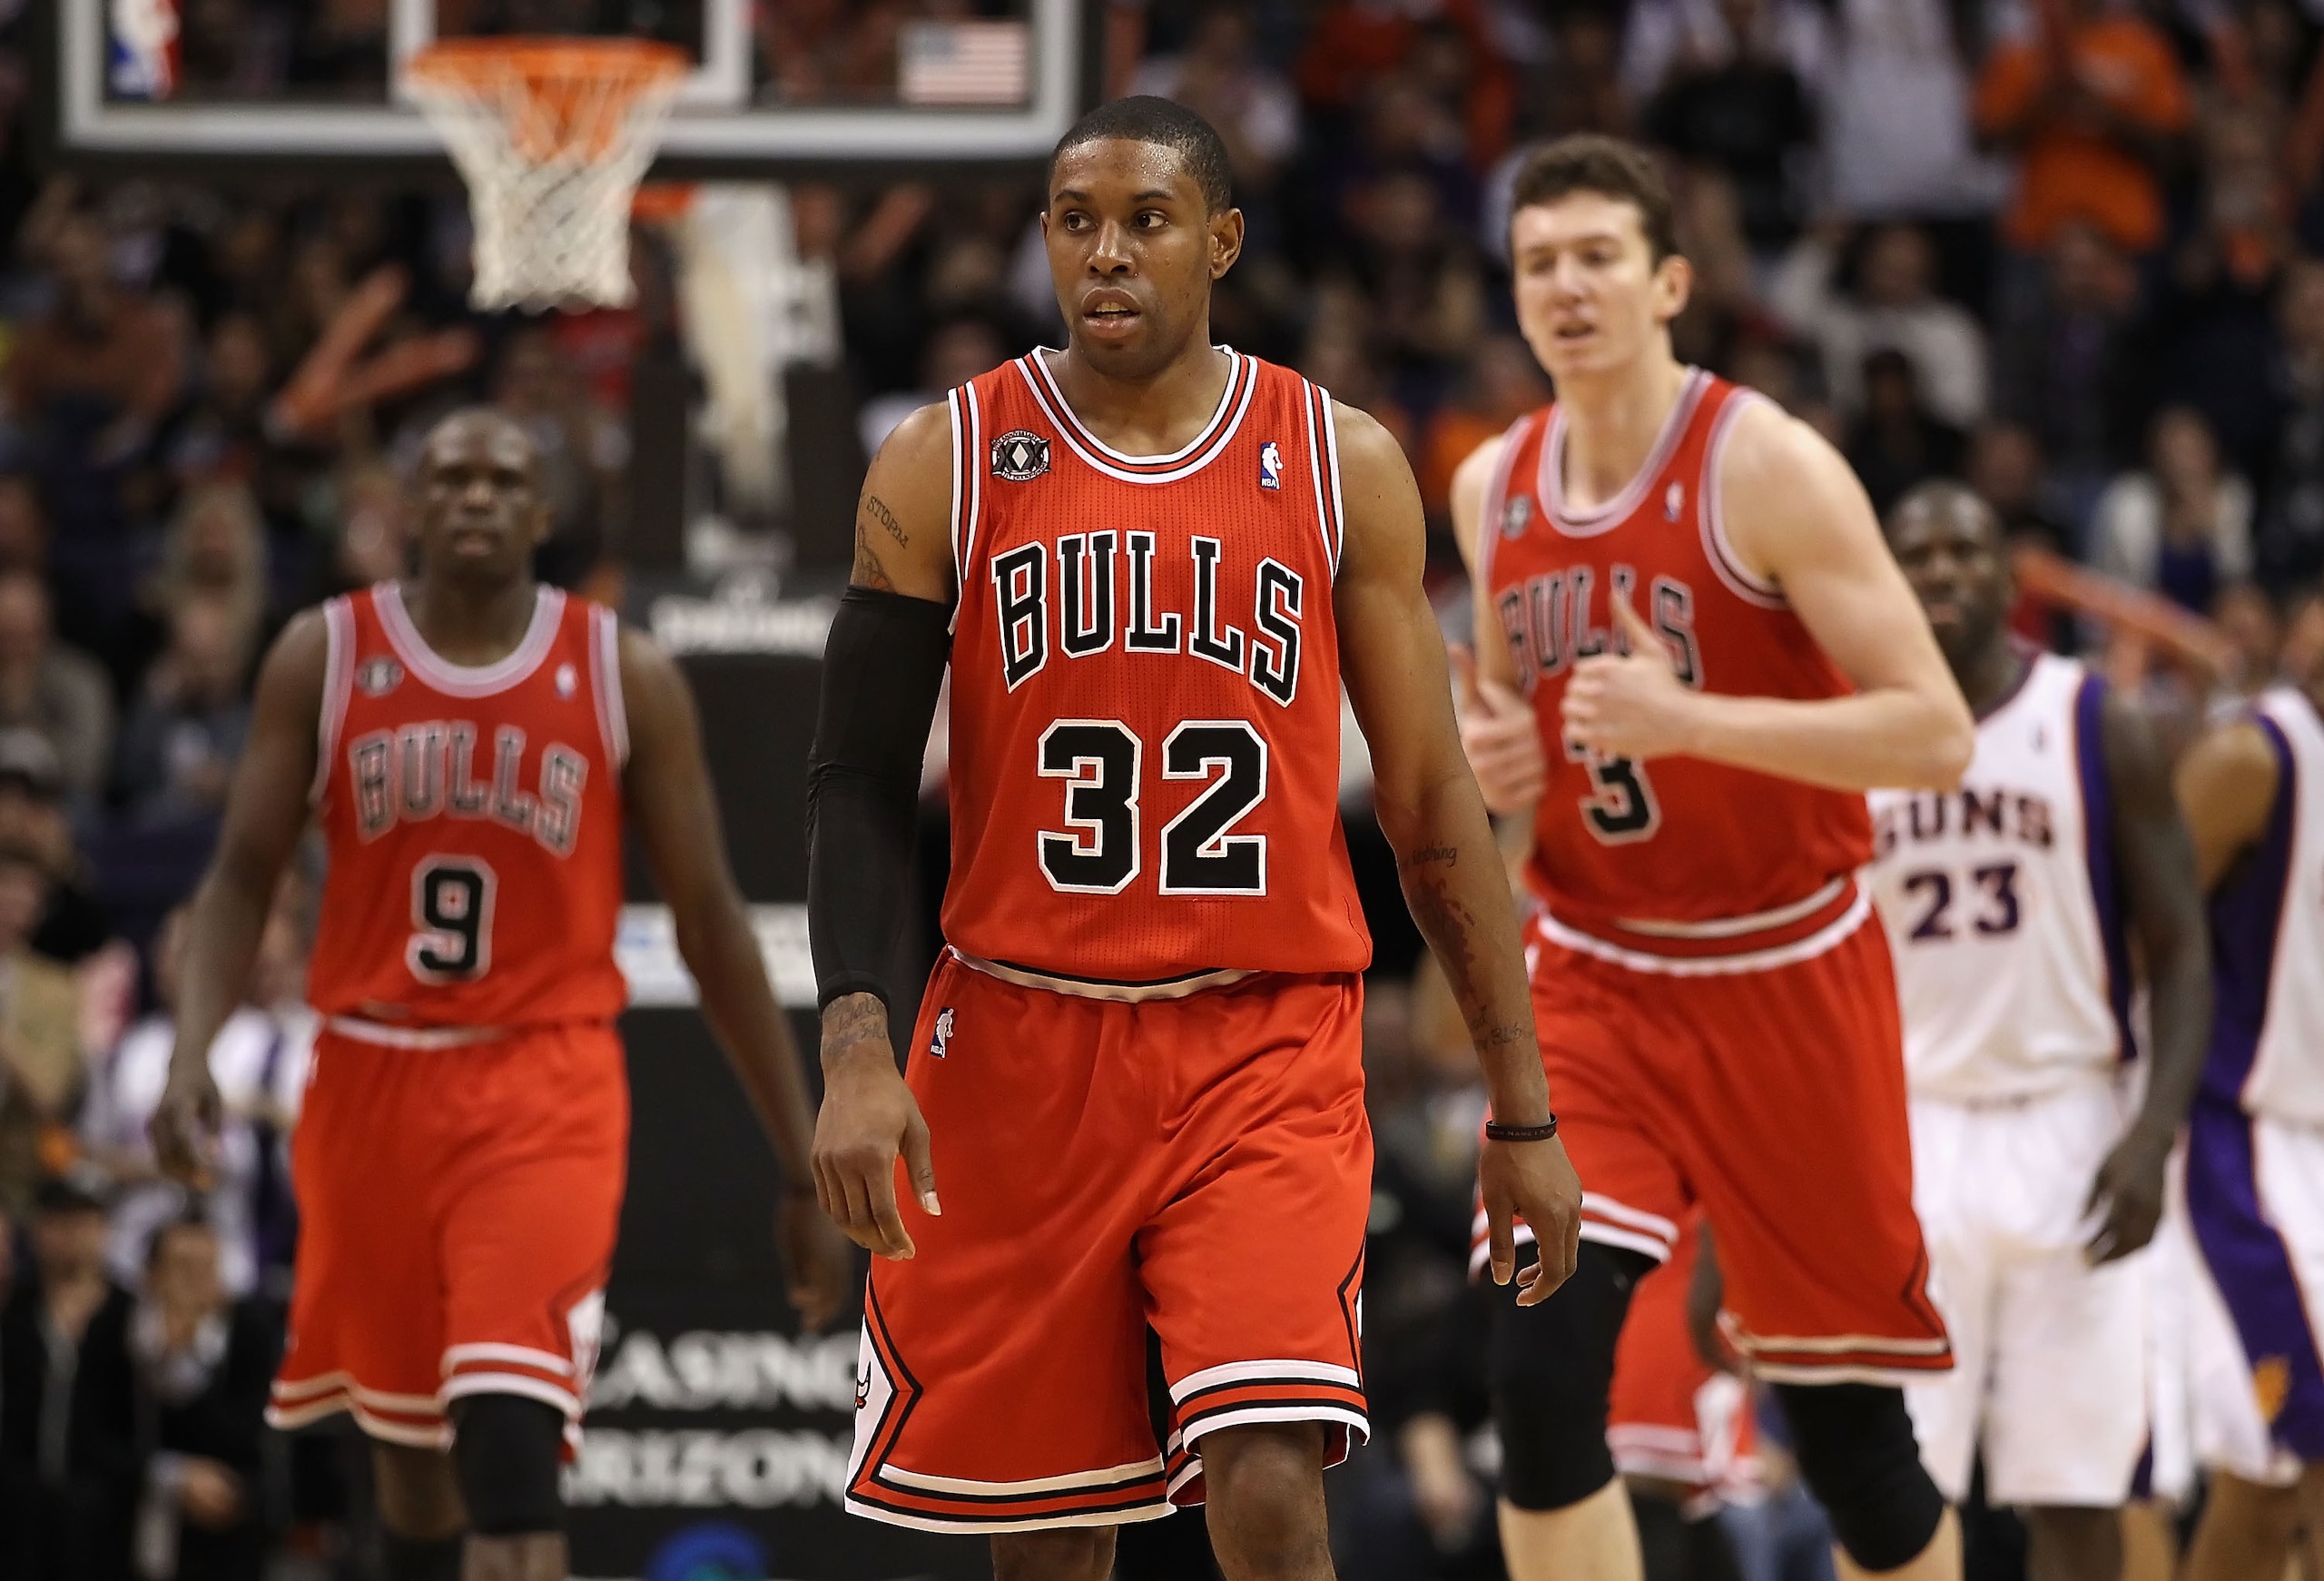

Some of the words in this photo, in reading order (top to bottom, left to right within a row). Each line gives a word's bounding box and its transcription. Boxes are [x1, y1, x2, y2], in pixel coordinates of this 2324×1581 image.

[866, 495, 909, 549] STORM
[1262, 478, 1276, 488] NBA
[990, 529, 1304, 707] BULLS
[349, 721, 589, 858] BULLS
[1038, 718, 1267, 895] 32
[1873, 787, 2053, 859] SUNS
[405, 853, 497, 985] 9
[1905, 863, 2021, 943] 23
[931, 1044, 943, 1055] NBA
